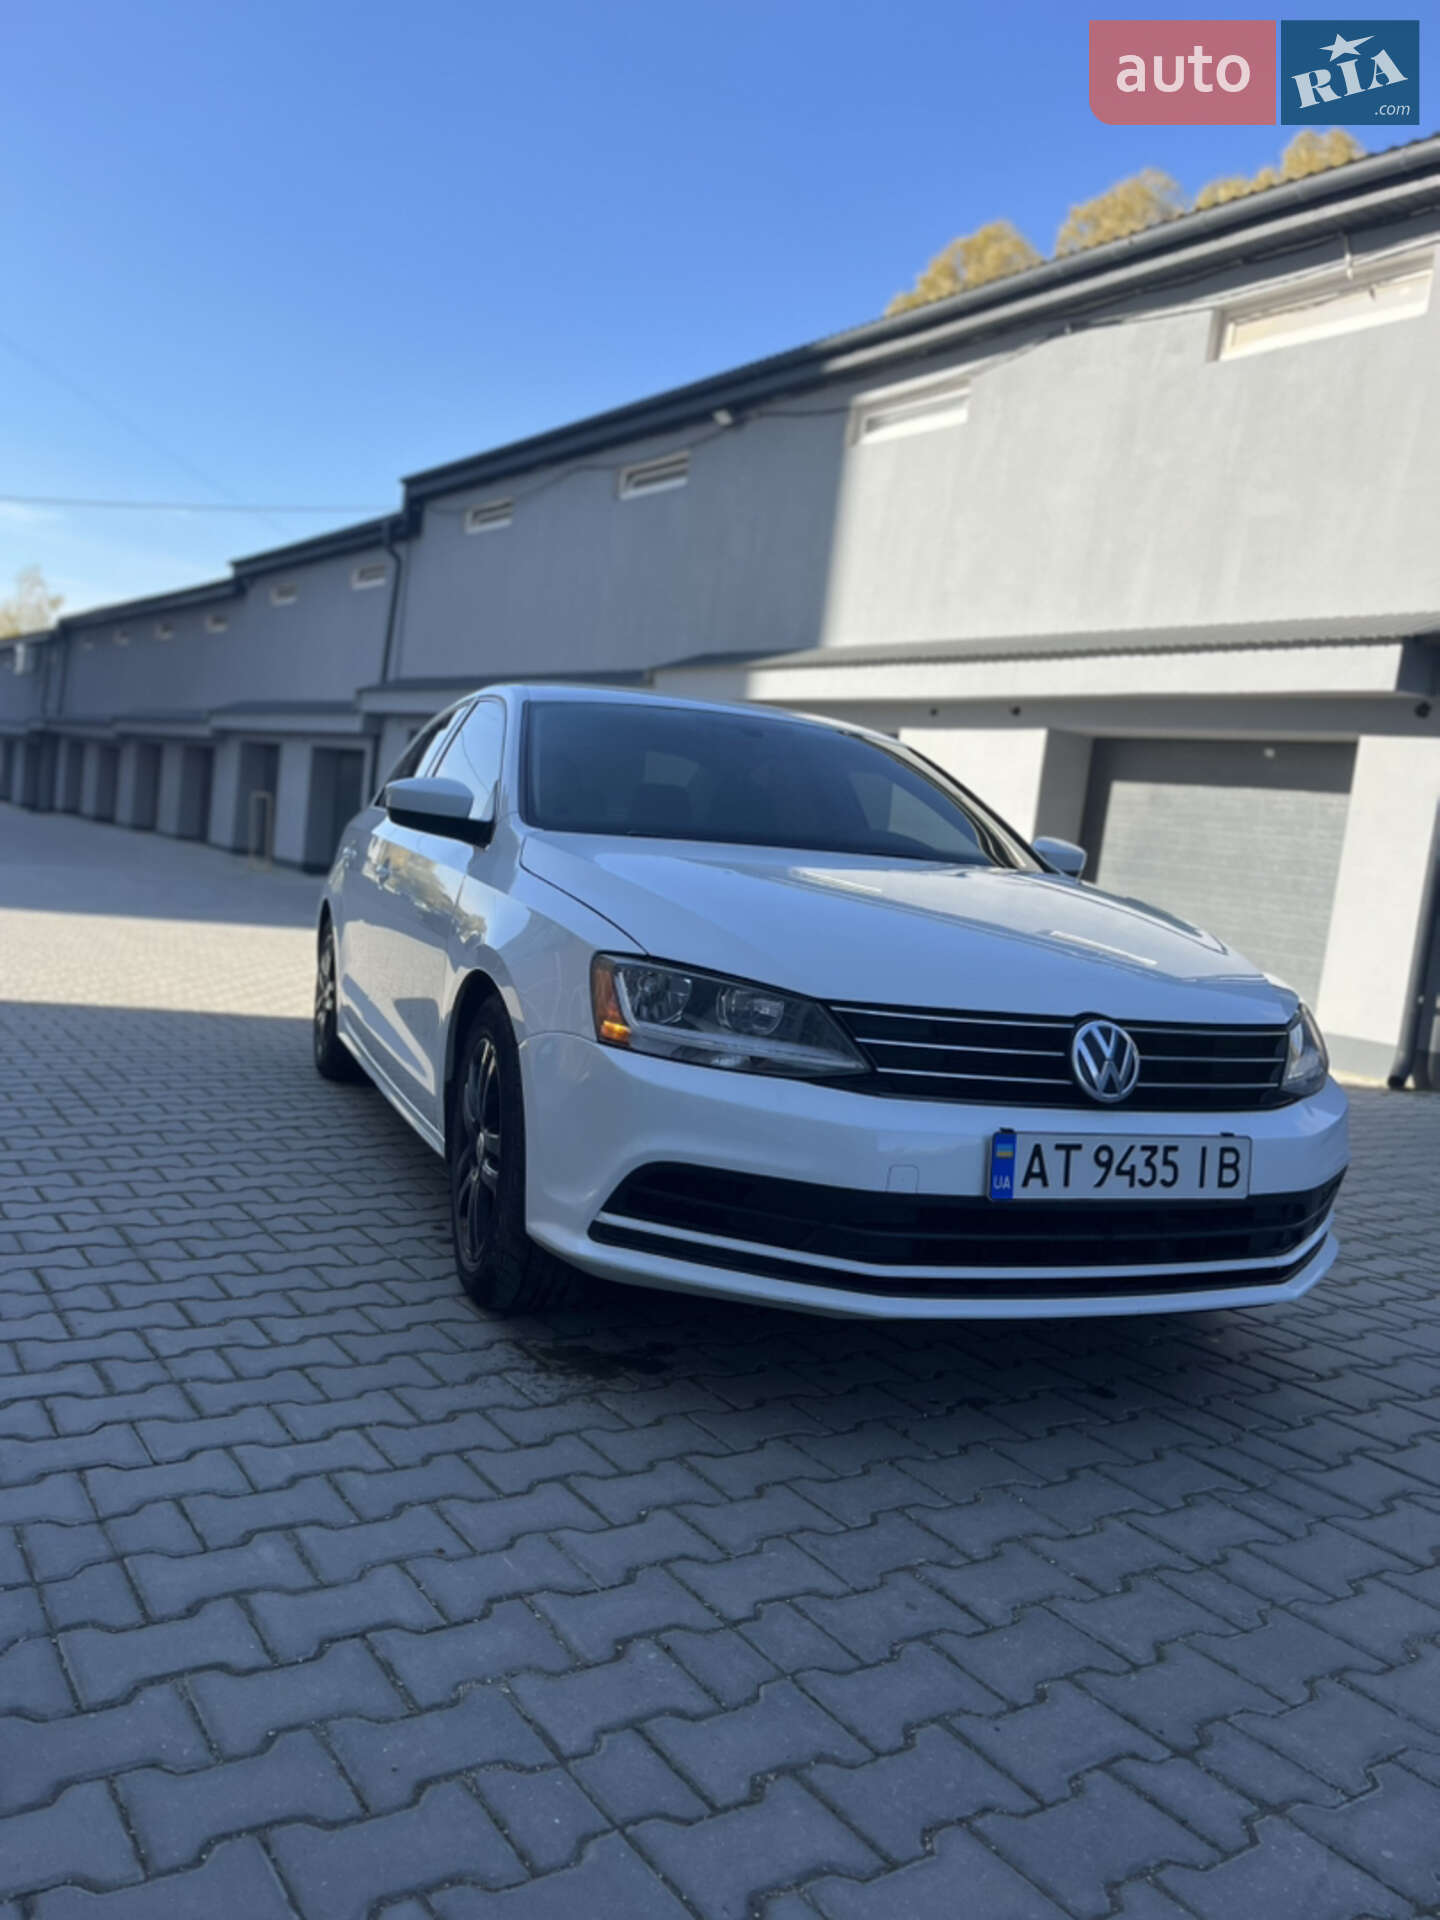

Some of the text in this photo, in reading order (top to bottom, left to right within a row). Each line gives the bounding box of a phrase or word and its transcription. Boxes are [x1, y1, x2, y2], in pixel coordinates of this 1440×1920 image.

[1021, 1143, 1240, 1189] AT 9435 IB
[993, 1175, 1011, 1189] UA
